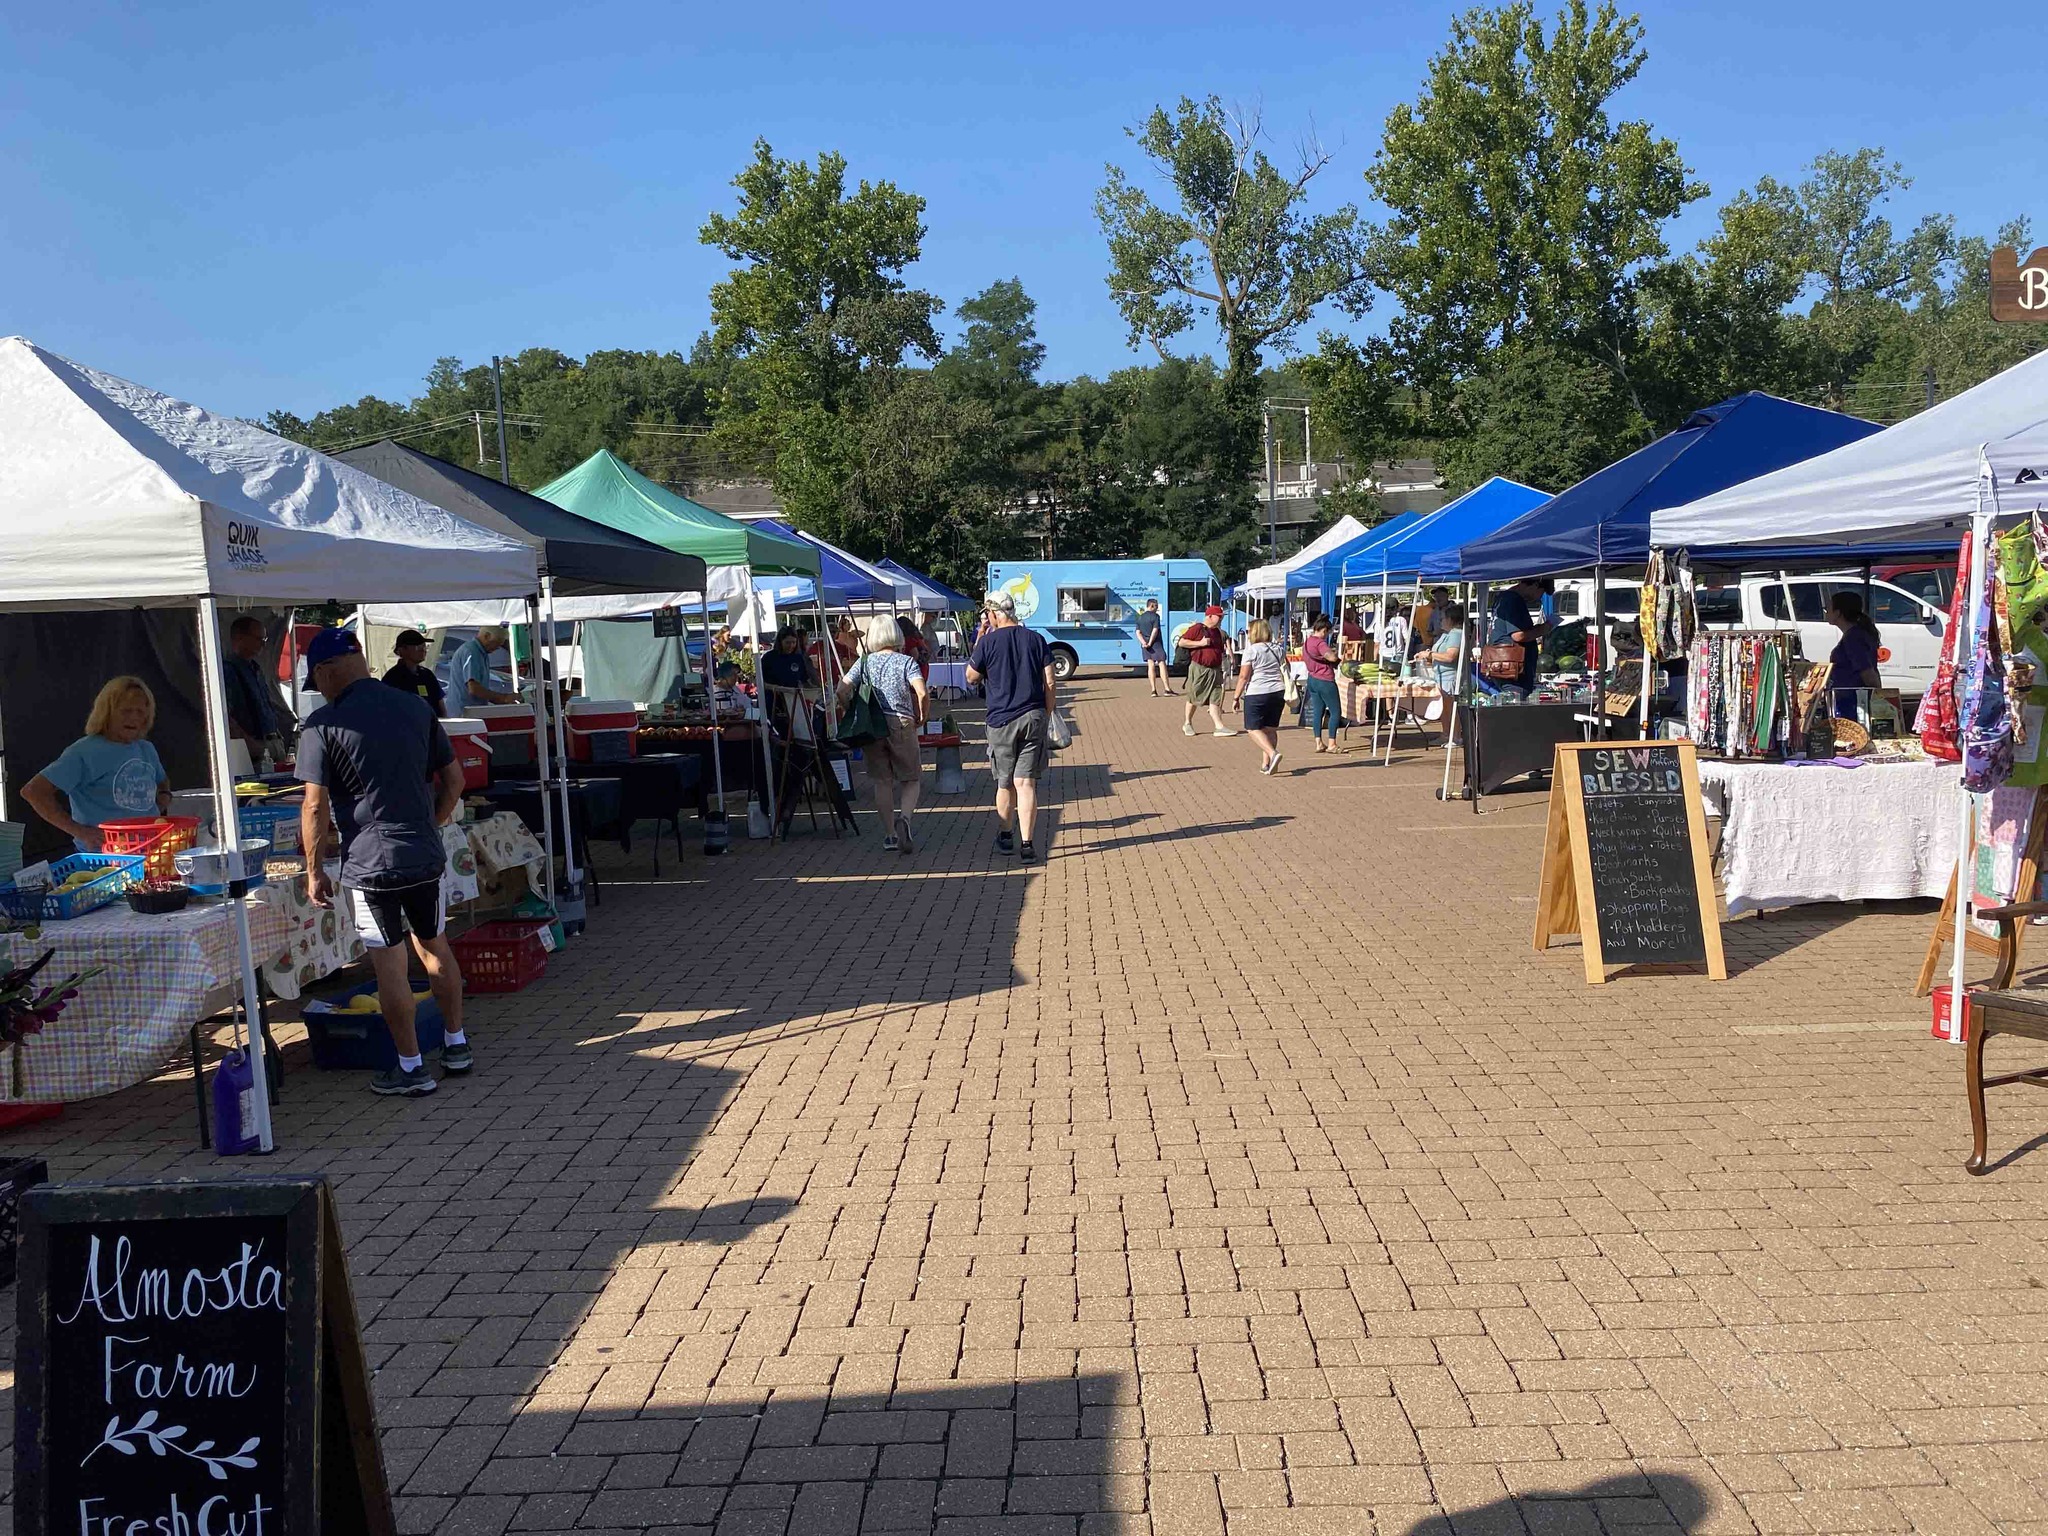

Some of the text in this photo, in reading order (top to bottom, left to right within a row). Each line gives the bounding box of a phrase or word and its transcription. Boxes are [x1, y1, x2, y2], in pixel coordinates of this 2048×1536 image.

[228, 521, 259, 547] QUIK
[227, 545, 268, 564] SHADE
[1594, 749, 1650, 772] SEW
[1583, 770, 1680, 794] BLESSED
[105, 1336, 257, 1404] Farm
